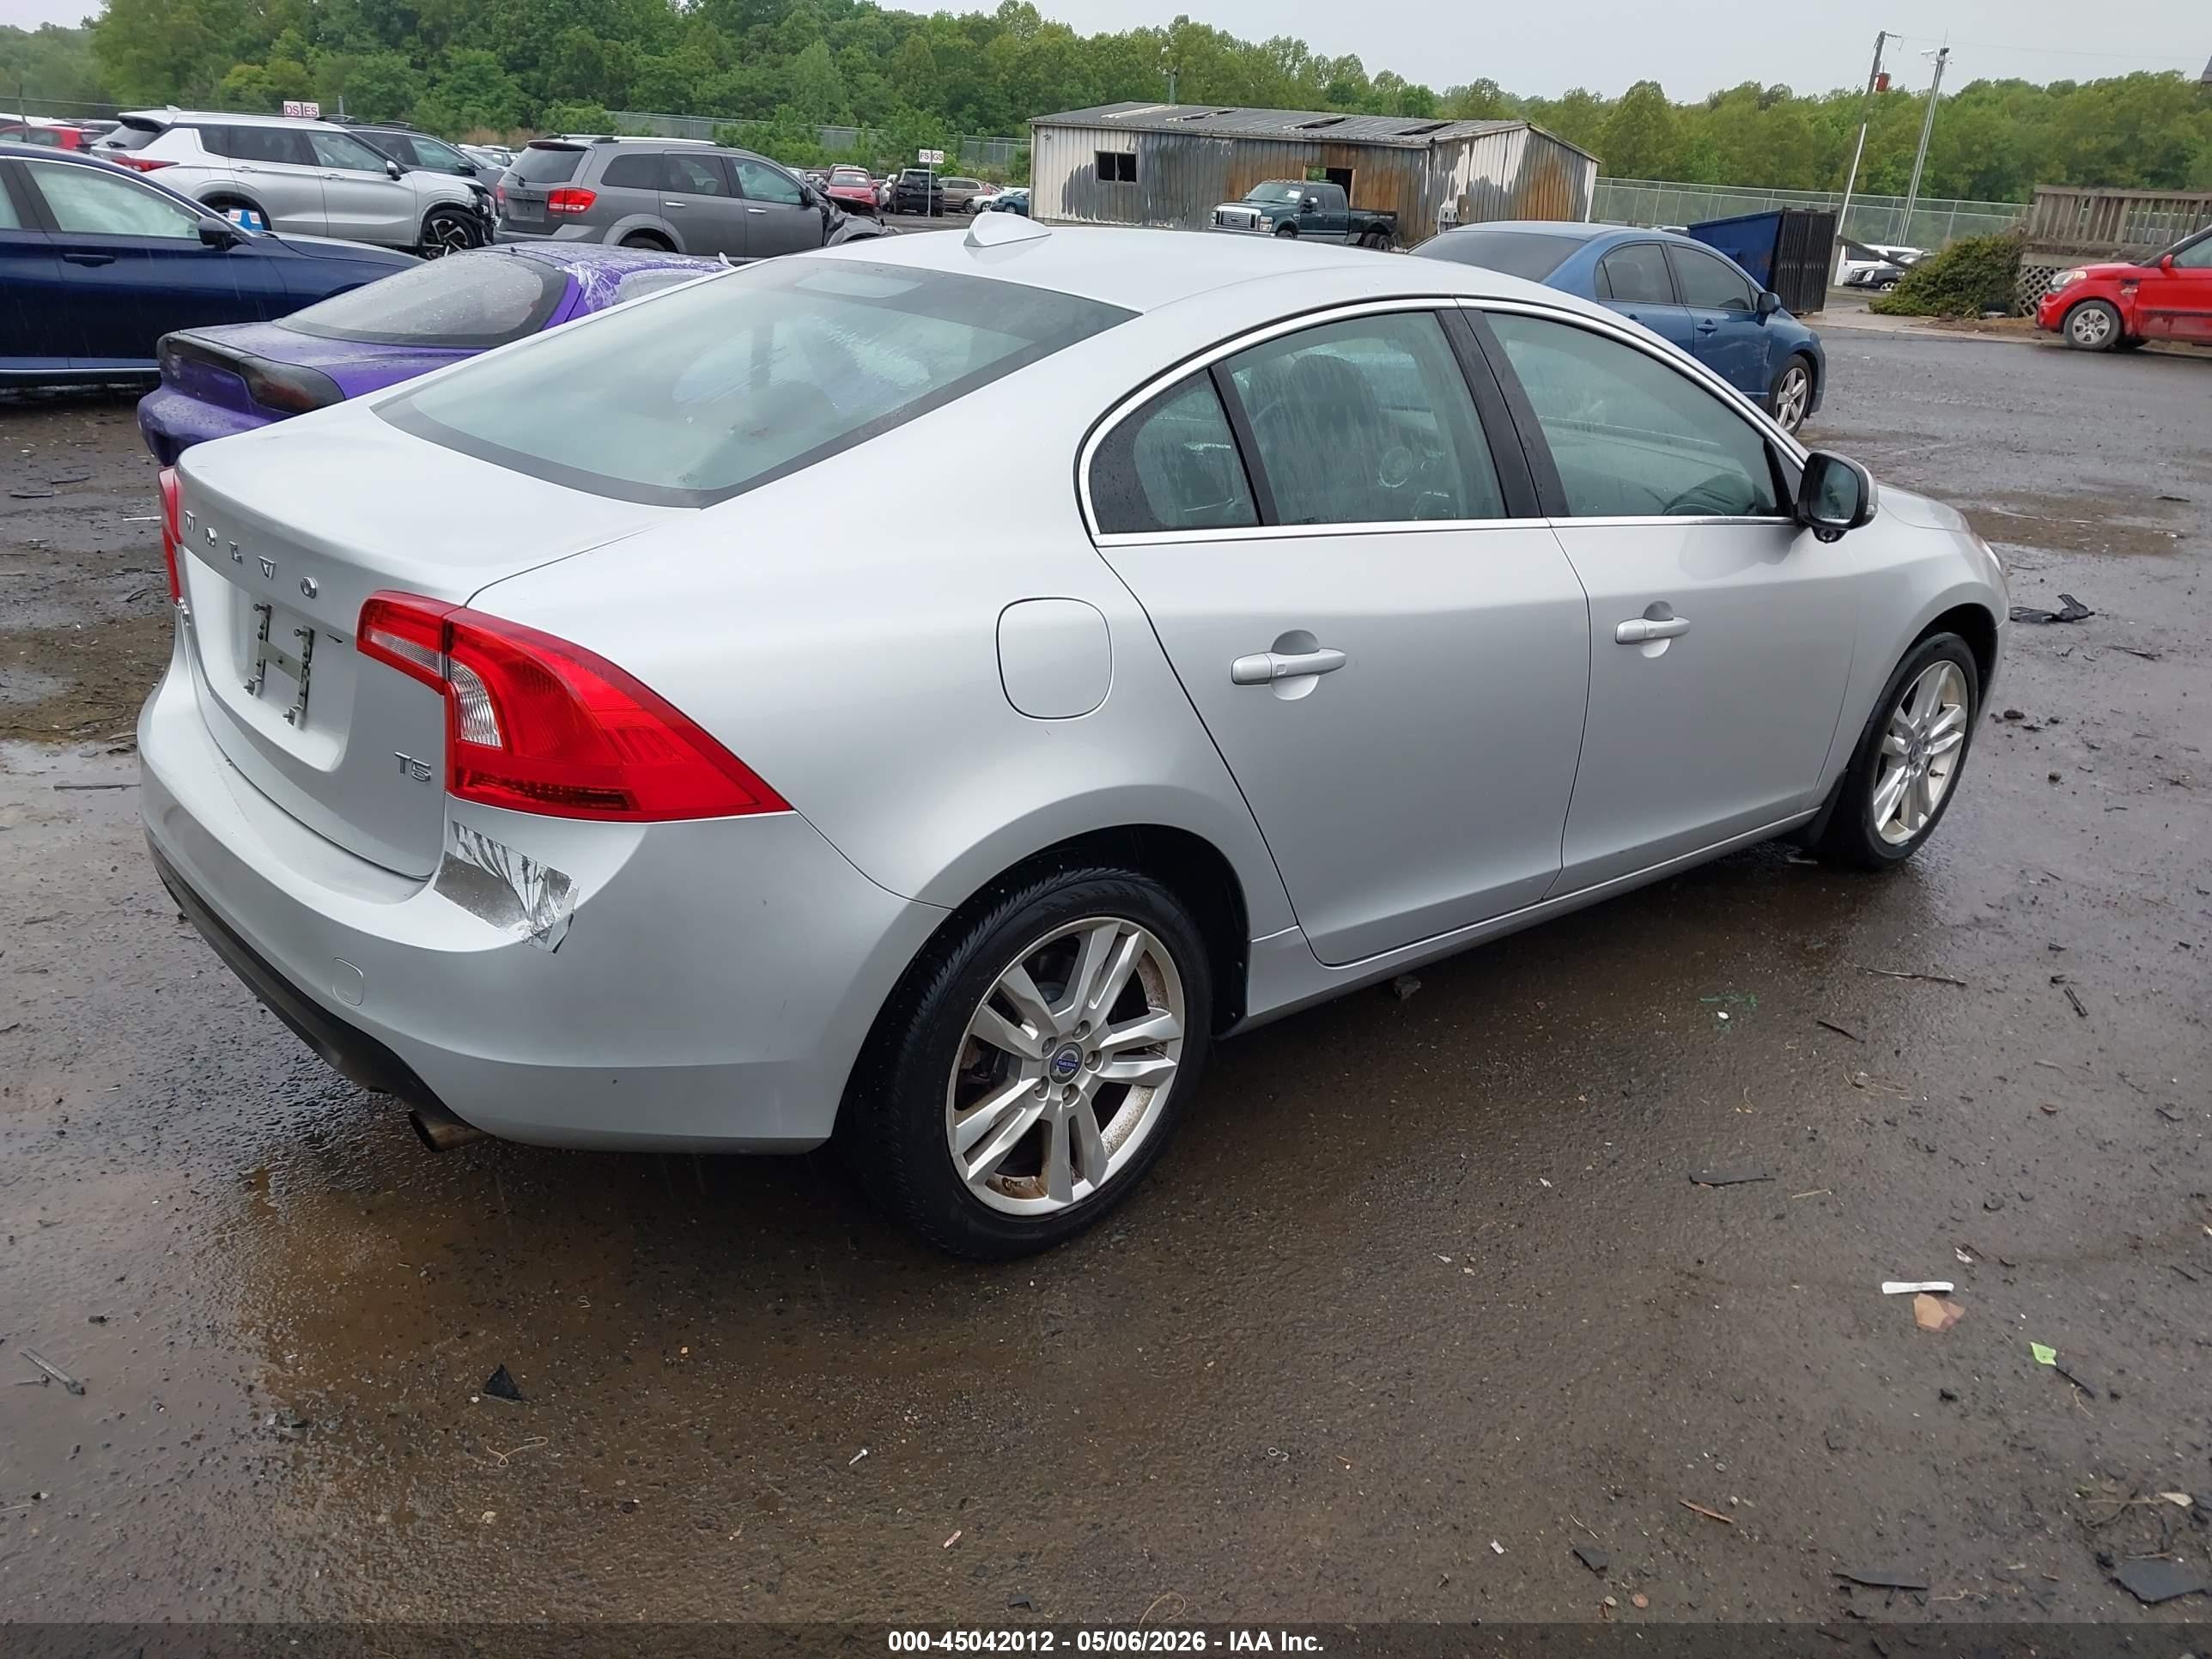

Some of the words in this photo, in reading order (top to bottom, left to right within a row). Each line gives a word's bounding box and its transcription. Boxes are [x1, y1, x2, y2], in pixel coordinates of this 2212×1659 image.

[285, 105, 300, 115] DS
[305, 106, 318, 116] ES
[185, 509, 319, 599] VOLVO
[394, 750, 432, 783] T5
